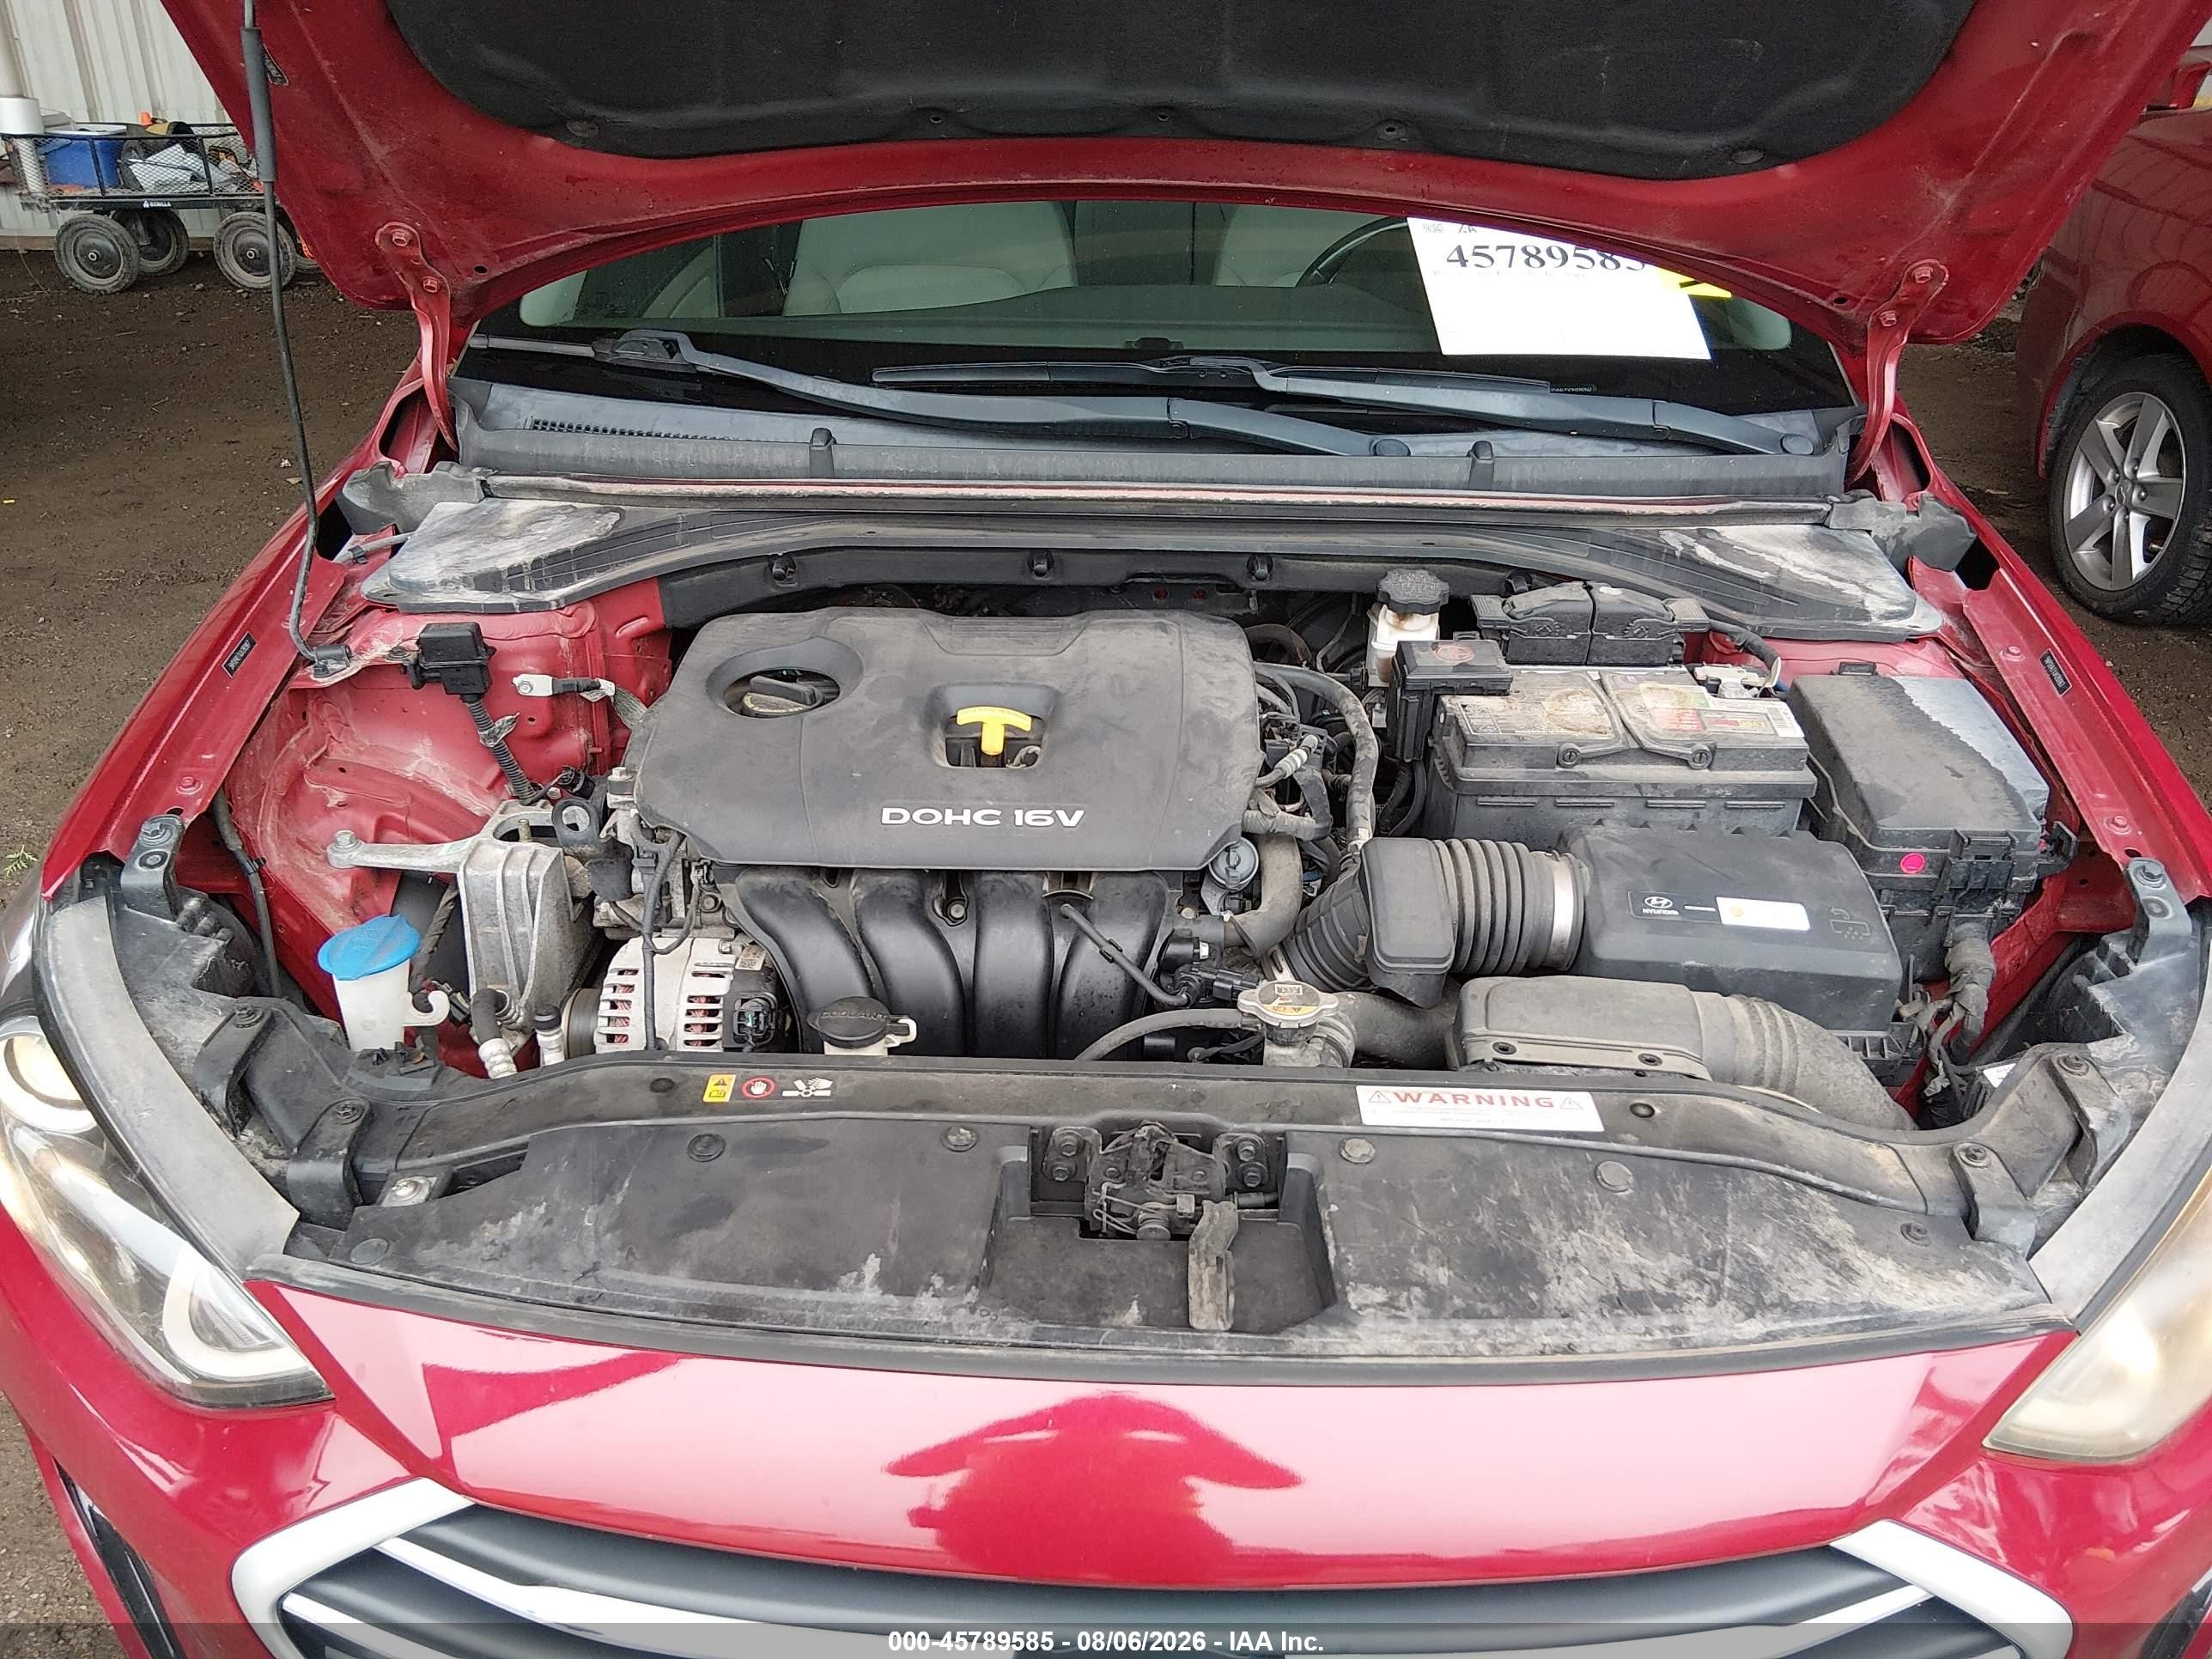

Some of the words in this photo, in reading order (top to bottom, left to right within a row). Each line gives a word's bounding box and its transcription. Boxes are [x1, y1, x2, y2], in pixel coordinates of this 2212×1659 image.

[881, 807, 1002, 826] DOHC
[1014, 809, 1085, 828] 16V
[1393, 1091, 1555, 1109] WARNING
